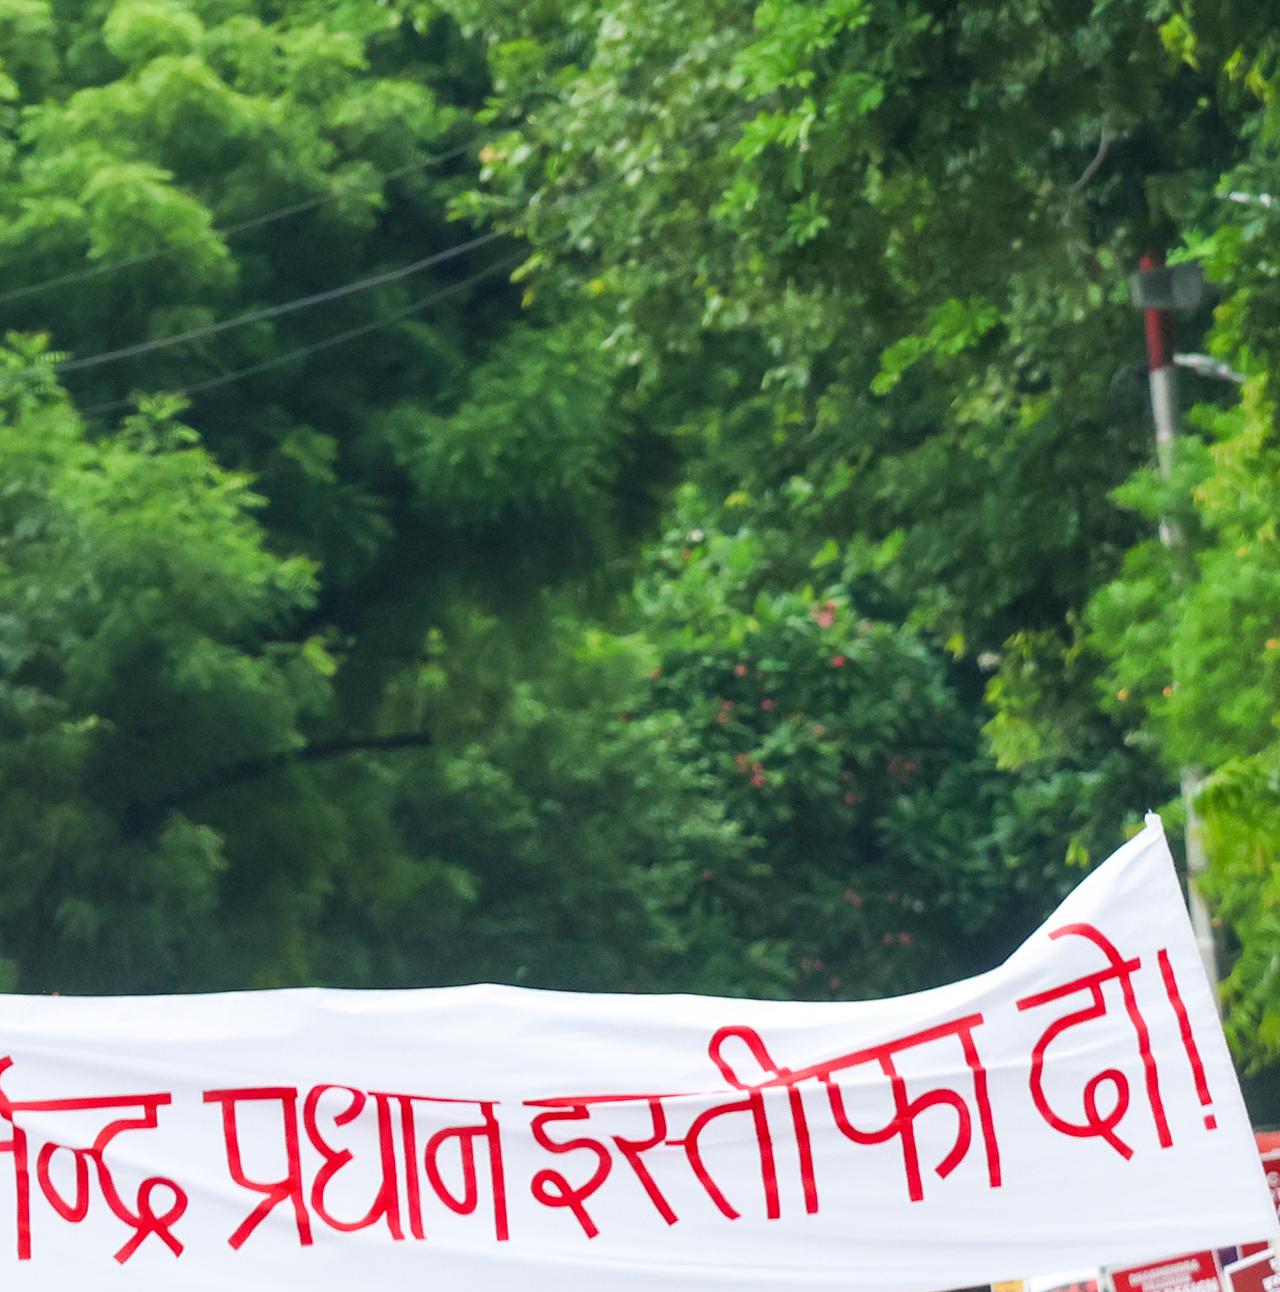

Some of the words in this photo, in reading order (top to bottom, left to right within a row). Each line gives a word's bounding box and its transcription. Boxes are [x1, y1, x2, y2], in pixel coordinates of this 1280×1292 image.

[203, 1084, 510, 1250] प्रधान
[523, 1012, 1002, 1239] इस्तीफा
[1017, 922, 1218, 1161] दो!
